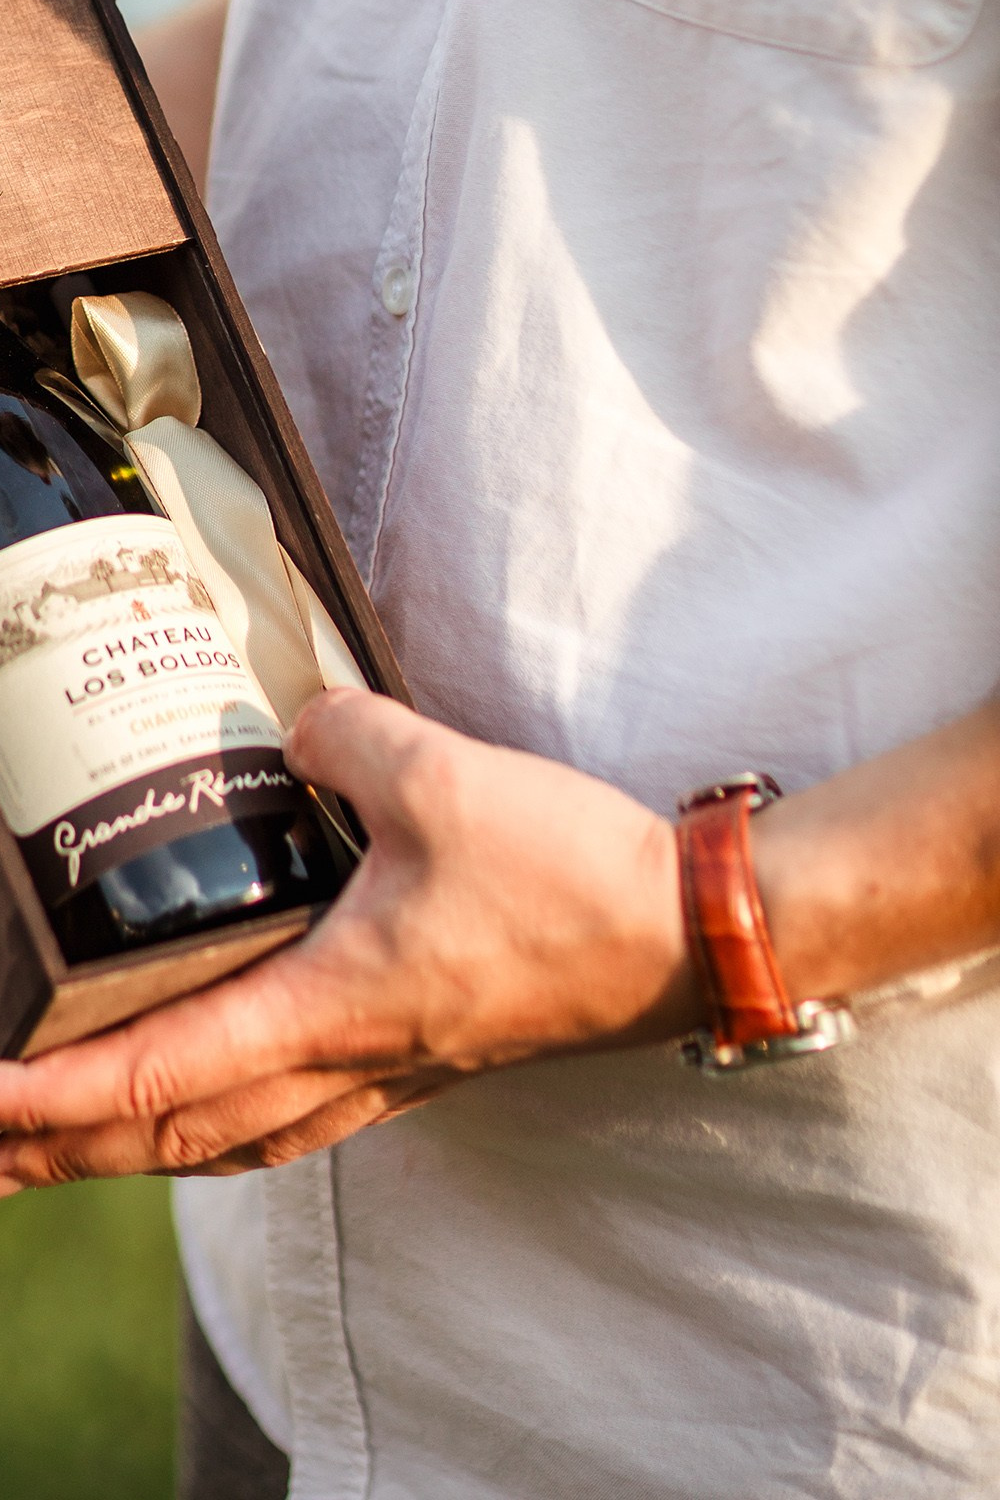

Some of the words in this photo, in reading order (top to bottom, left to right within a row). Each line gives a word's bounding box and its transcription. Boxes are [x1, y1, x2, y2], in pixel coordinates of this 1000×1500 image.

[83, 627, 212, 666] CHATEAU
[65, 670, 125, 705] LOS
[138, 651, 240, 678] BOLDOS
[54, 788, 186, 887] Grande
